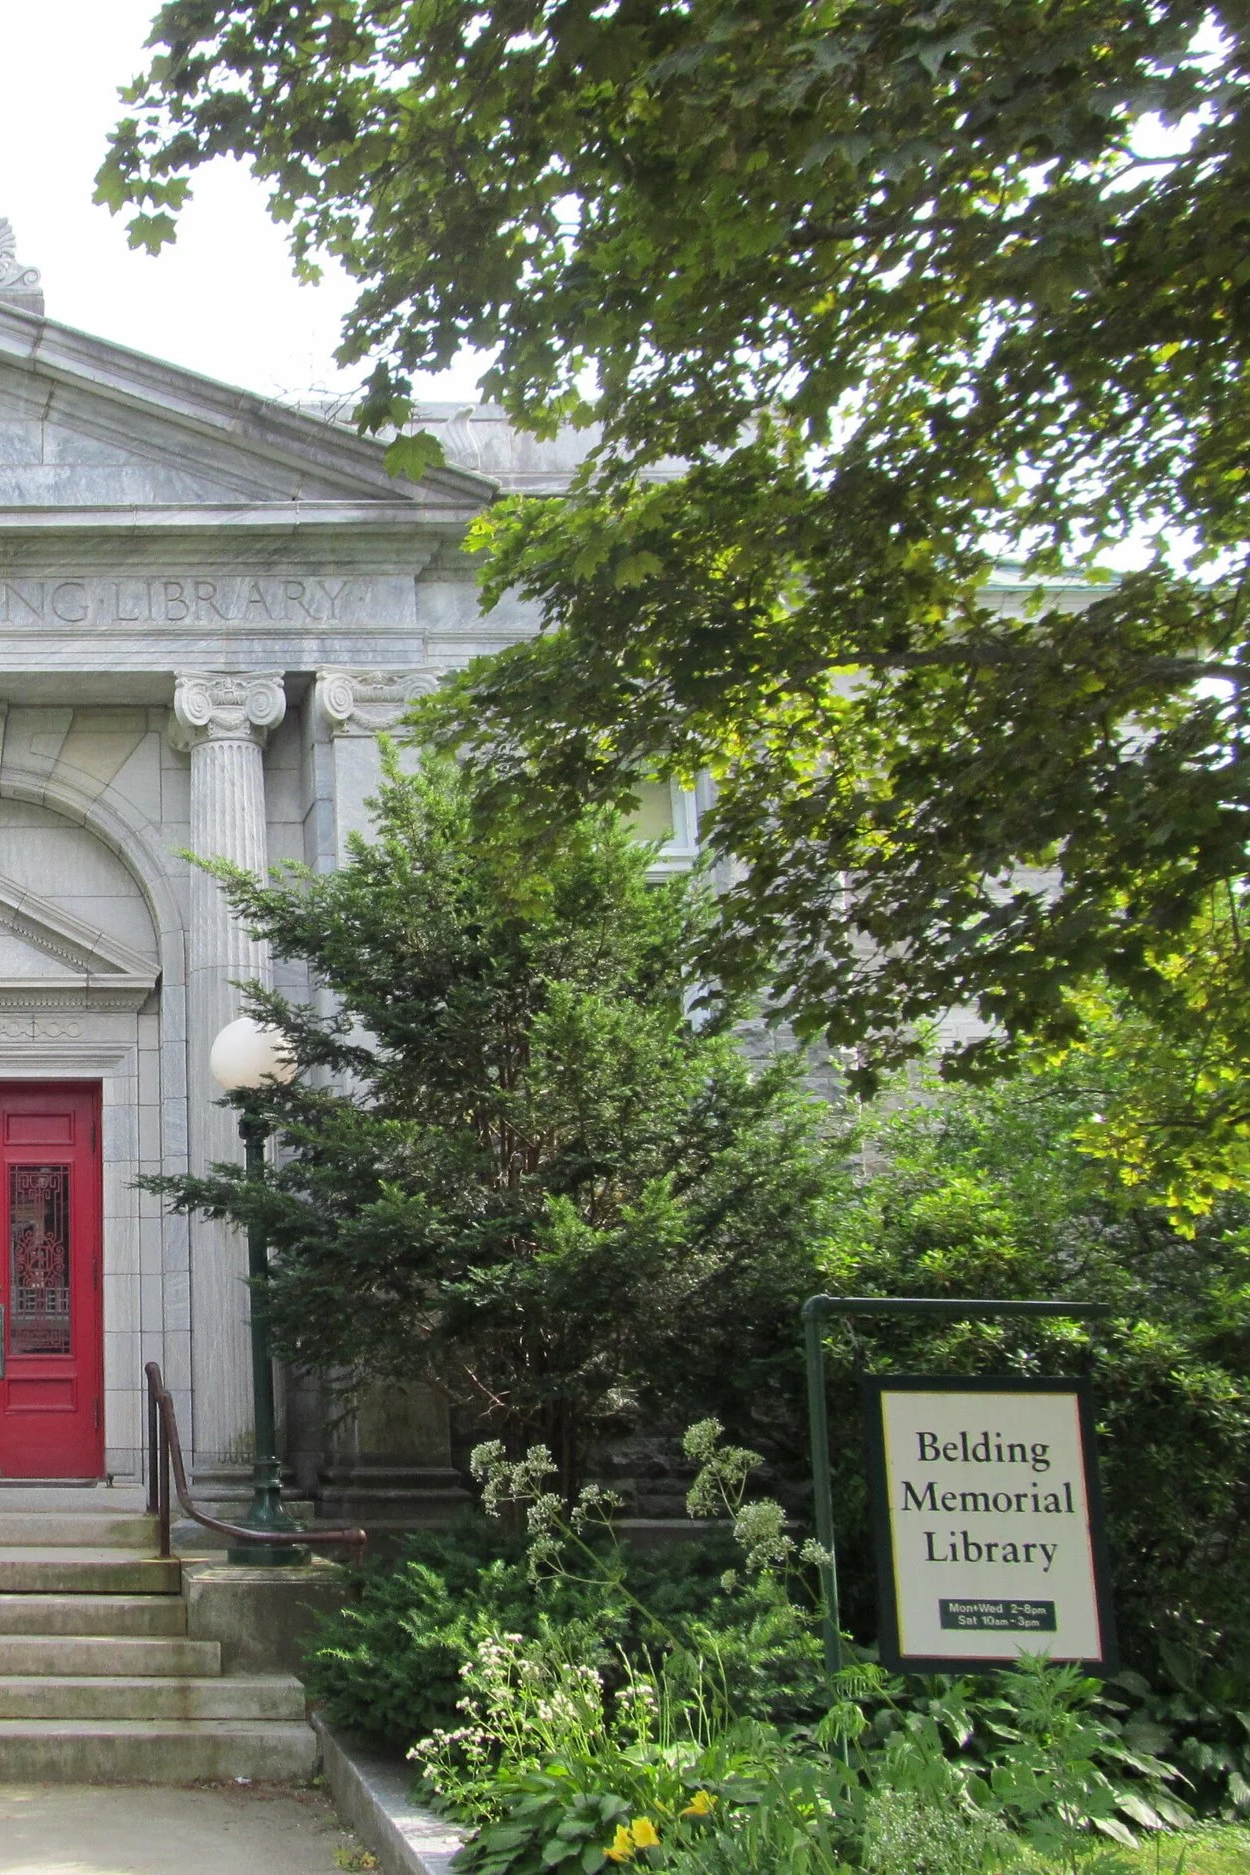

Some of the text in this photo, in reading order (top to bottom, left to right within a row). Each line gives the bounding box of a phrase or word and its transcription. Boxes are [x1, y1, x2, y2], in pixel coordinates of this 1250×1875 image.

[112, 580, 350, 622] LIBRARY
[915, 1431, 1050, 1472] Belding
[901, 1480, 1075, 1514] Memorial
[923, 1530, 1058, 1572] Library
[958, 1615, 978, 1626] Sat
